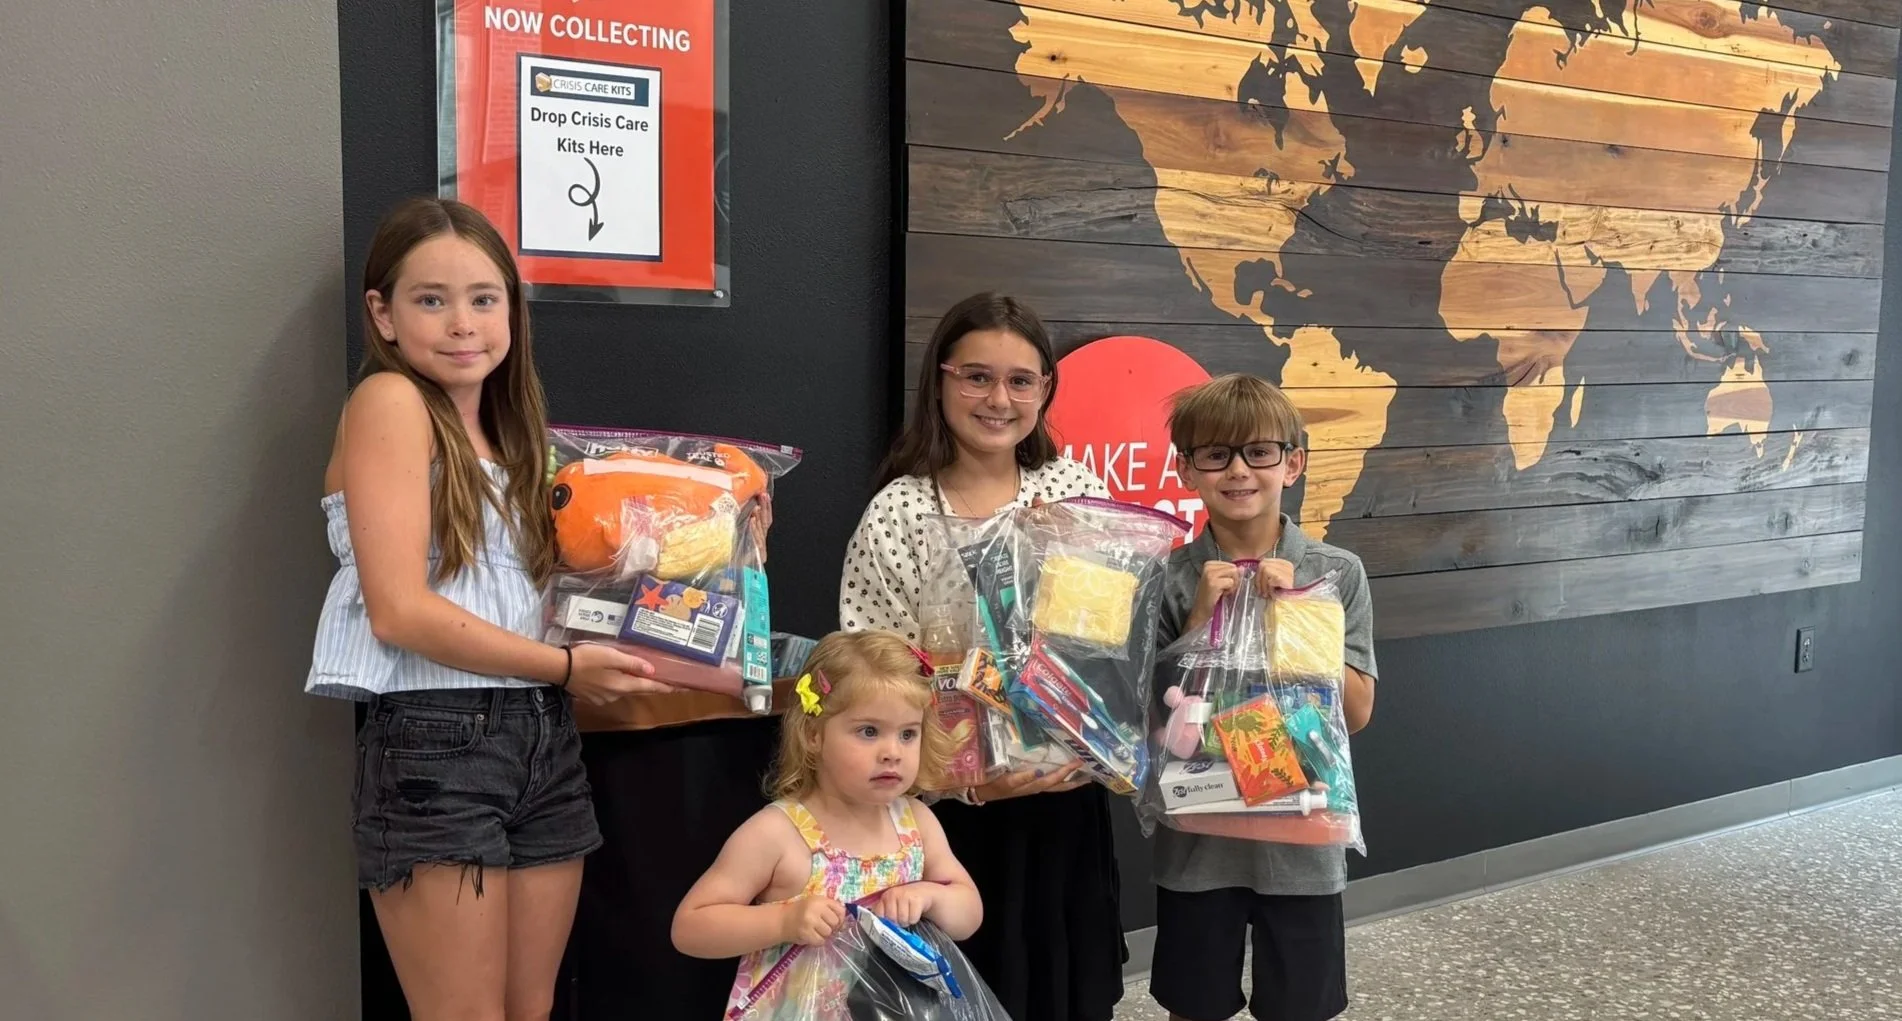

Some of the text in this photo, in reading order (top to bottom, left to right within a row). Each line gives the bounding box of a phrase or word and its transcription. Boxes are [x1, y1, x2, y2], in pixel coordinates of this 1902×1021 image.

[484, 6, 691, 52] NOW COLLECTING
[553, 79, 632, 97] CRISIS CARE KITS
[530, 107, 649, 132] Drop Crisis Care
[557, 137, 624, 157] Kits Here
[1064, 442, 1148, 491] AKE
